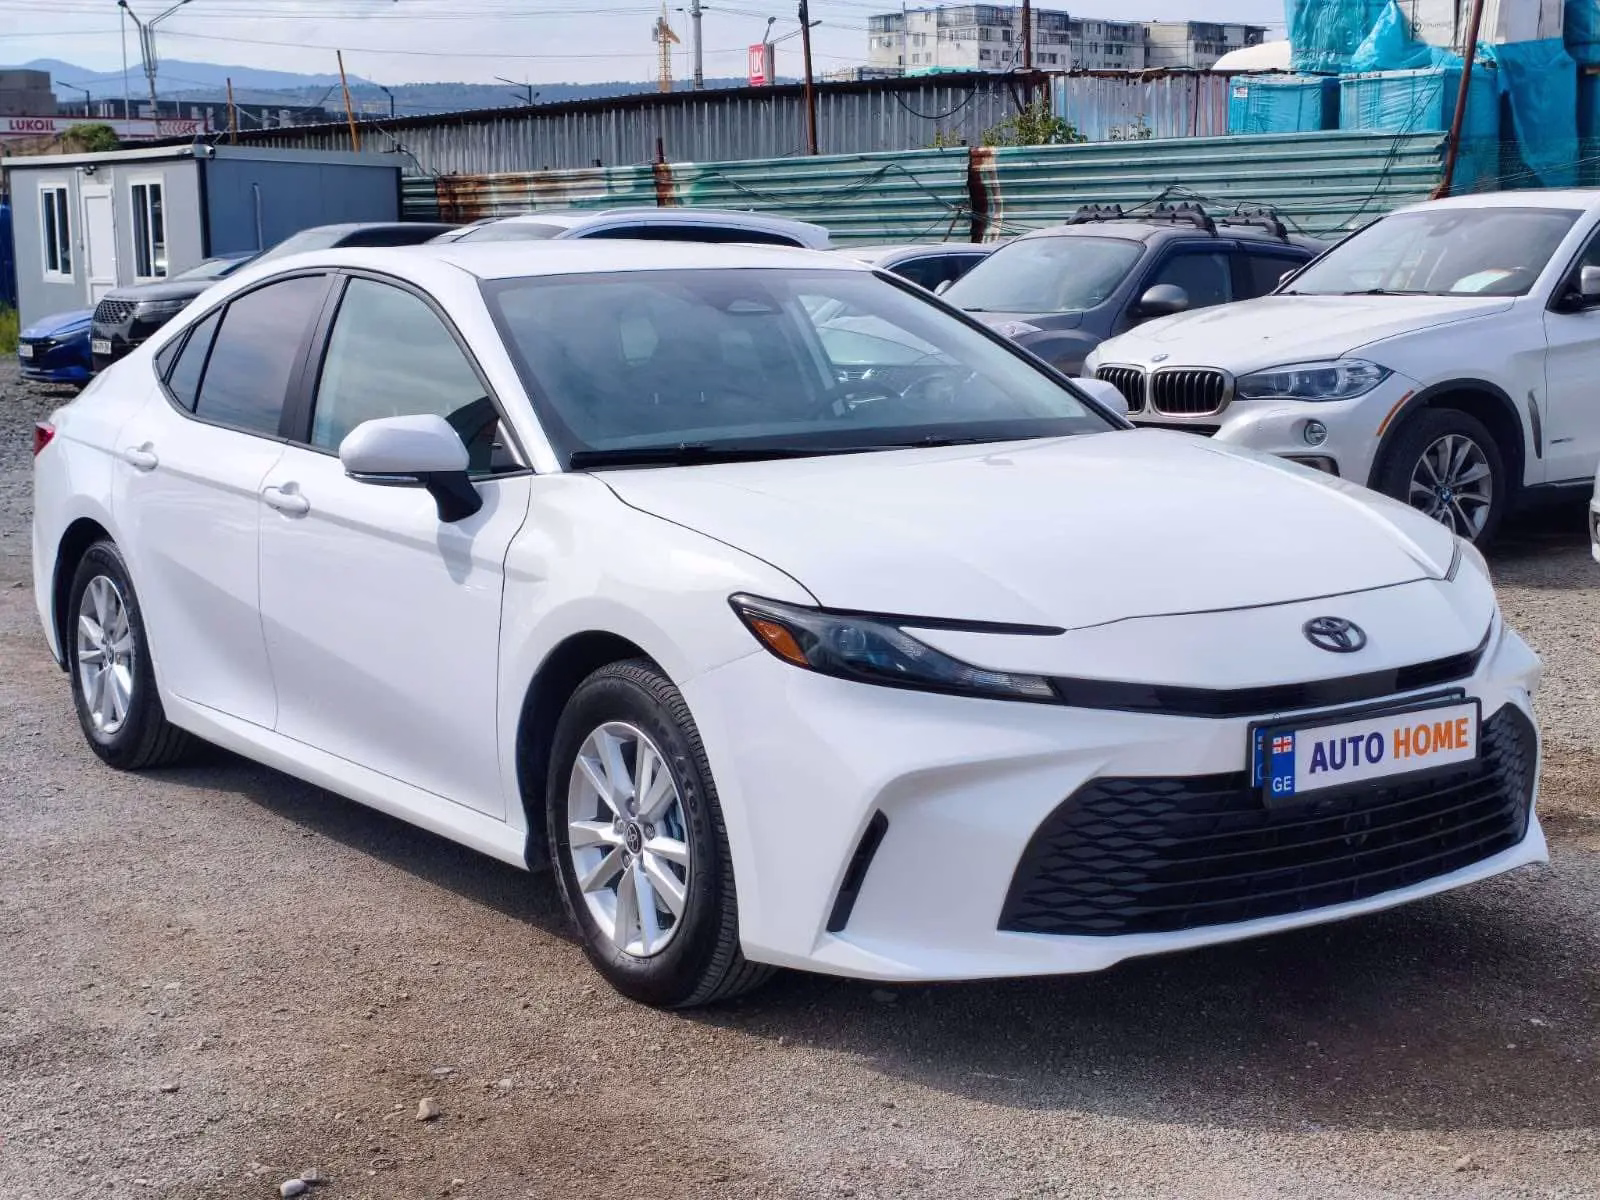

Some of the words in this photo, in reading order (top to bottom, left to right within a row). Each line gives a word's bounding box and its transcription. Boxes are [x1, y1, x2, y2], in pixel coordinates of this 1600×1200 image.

[9, 119, 57, 132] LUKOIL
[1309, 731, 1385, 774] AUTO
[1393, 717, 1469, 760] HOME
[1272, 775, 1293, 793] GE
